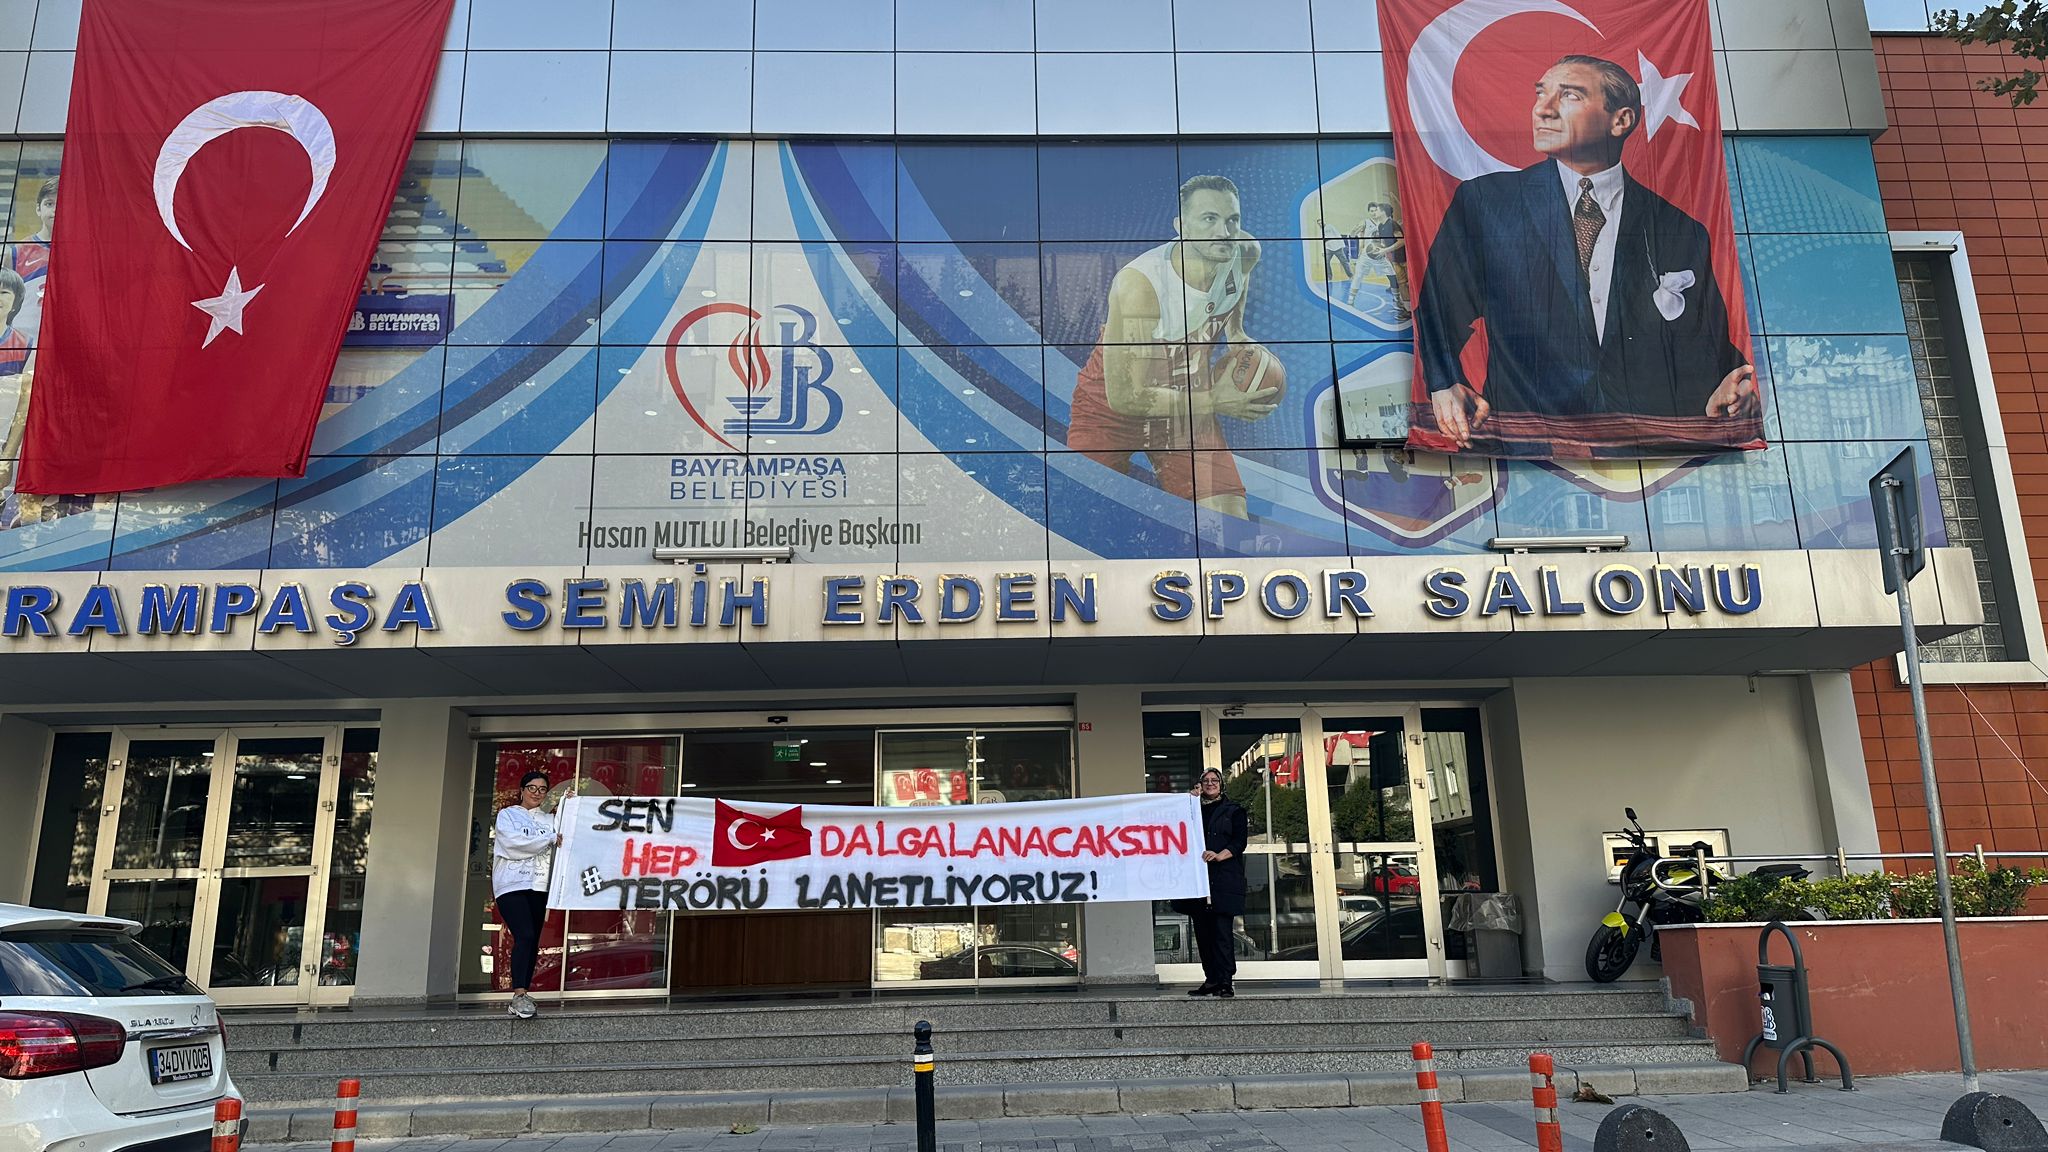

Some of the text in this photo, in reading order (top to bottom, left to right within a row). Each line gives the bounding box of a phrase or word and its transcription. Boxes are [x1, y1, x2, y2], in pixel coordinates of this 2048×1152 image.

[670, 457, 847, 480] BAYRAMPAŞA
[669, 475, 848, 500] BELEDİYESİ
[578, 521, 647, 549] Hasan
[653, 520, 726, 549] MUTLU
[745, 517, 833, 552] Belediye
[838, 516, 922, 549] Başkanı
[500, 562, 770, 631] SEMİH
[821, 572, 1099, 626] ERDEN
[1150, 568, 1376, 622] SPOR
[1424, 563, 1765, 618] SALONU
[591, 798, 677, 834] SEN
[621, 820, 1189, 878] HEP DALGALANACAKSIN
[795, 865, 1099, 908] LANETLİYORUZ!
[158, 1047, 209, 1074] 34DVV005
